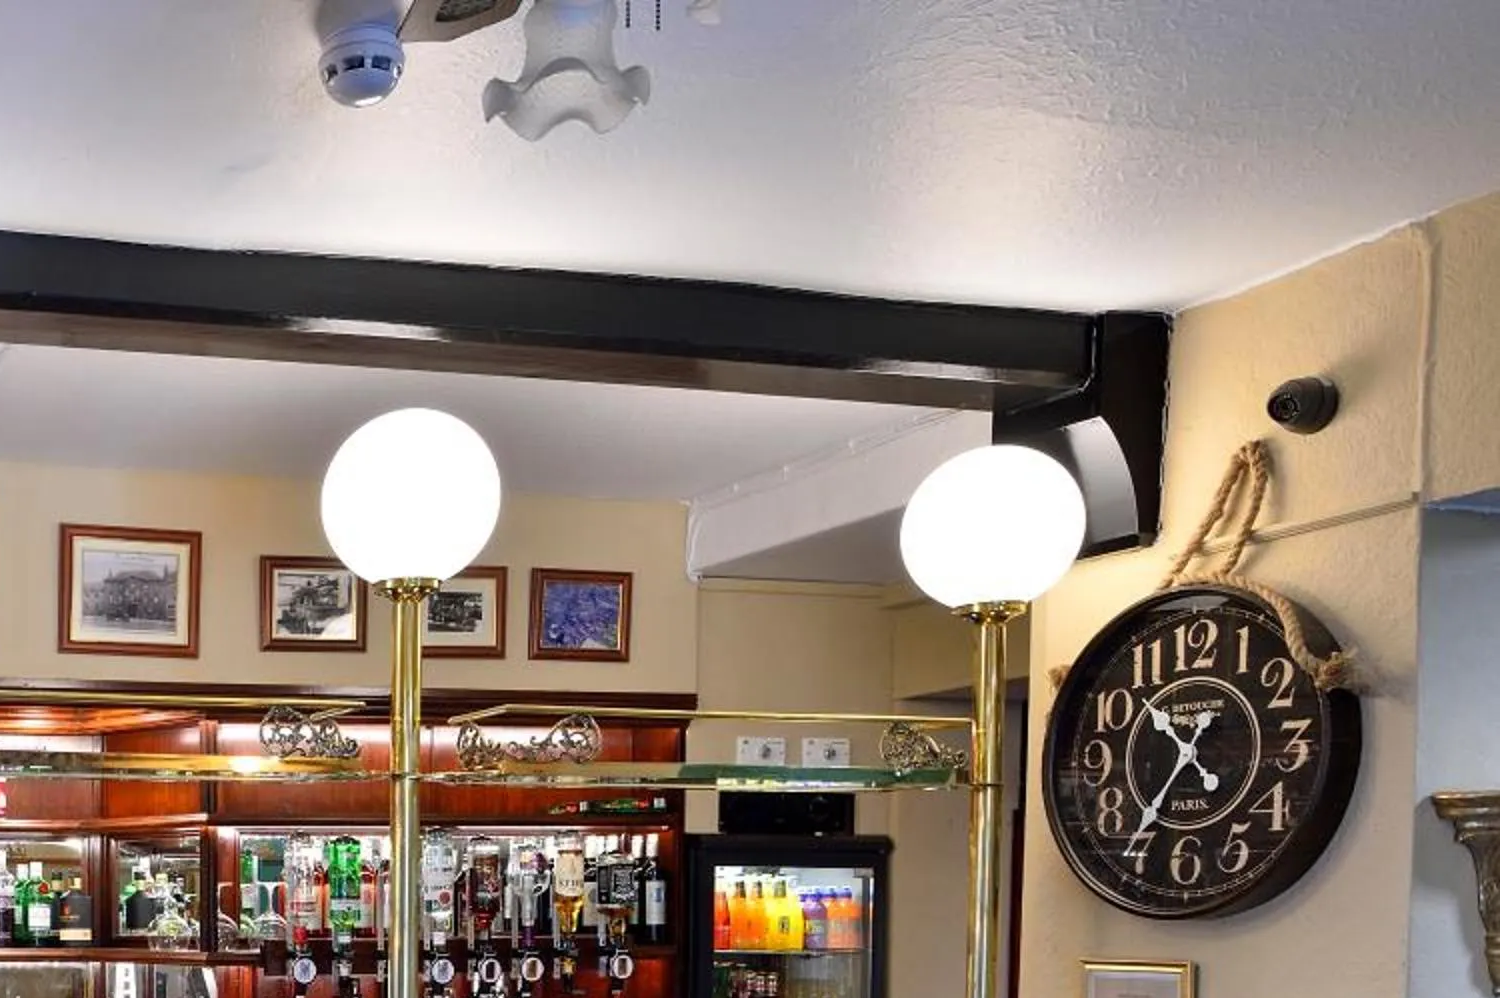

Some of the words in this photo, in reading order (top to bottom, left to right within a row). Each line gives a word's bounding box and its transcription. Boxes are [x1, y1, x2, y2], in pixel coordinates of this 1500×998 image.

[1131, 638, 1164, 689] 11
[1173, 619, 1219, 672] 12
[1235, 625, 1250, 674] 1
[1260, 657, 1296, 709] 2
[1096, 688, 1134, 733] 10
[1083, 740, 1113, 787] 9
[1275, 718, 1313, 773] 3
[1097, 787, 1124, 836] 8
[1171, 799, 1210, 811] PARIS
[1249, 781, 1290, 832] 4
[1170, 836, 1201, 886] 6
[1217, 821, 1251, 874] 5
